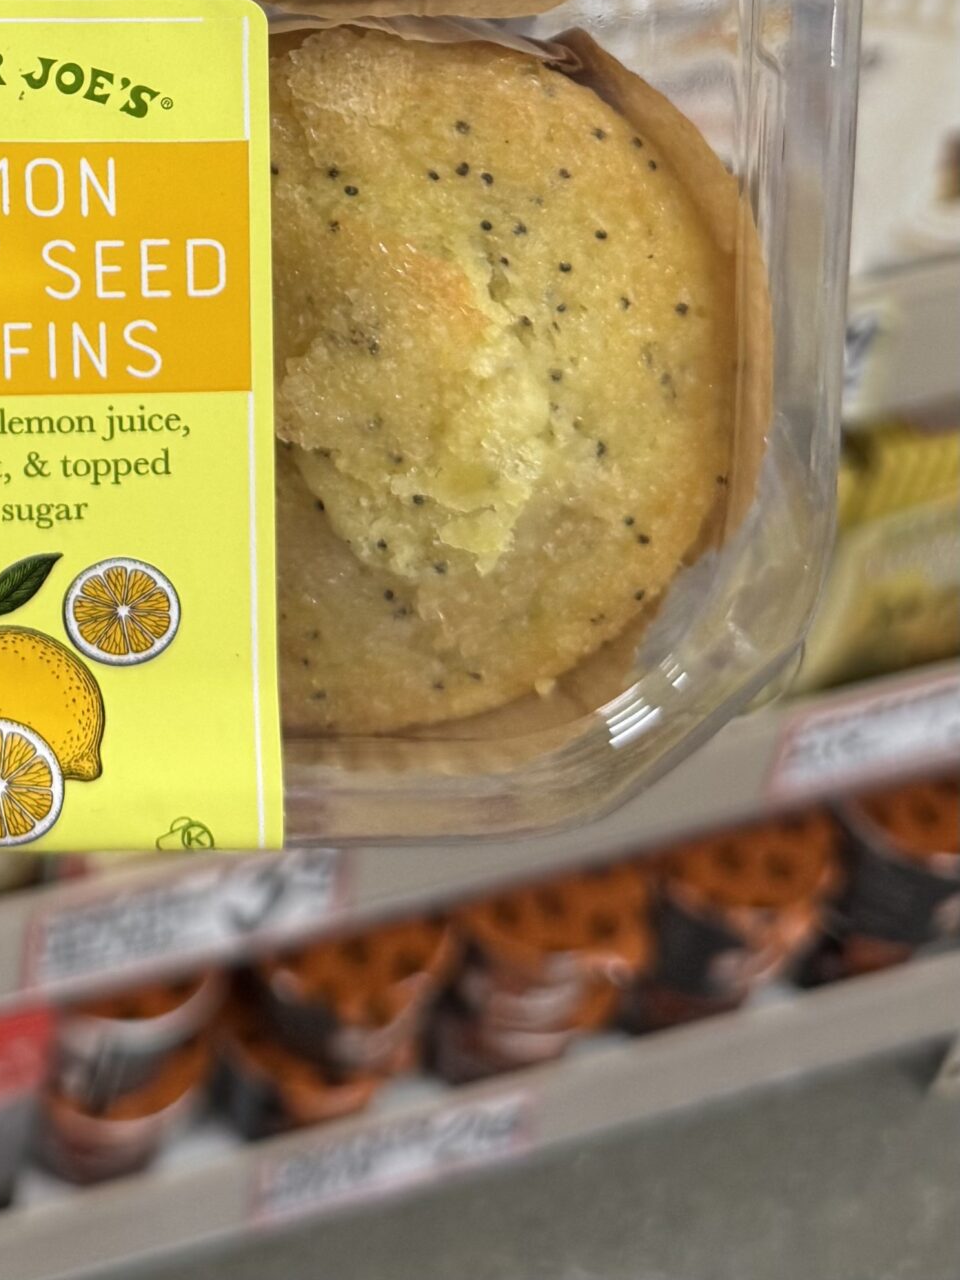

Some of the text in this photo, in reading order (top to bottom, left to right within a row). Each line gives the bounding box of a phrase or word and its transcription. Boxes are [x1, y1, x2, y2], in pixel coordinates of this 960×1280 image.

[41, 237, 228, 302] SEED
[101, 404, 192, 442] juice,
[22, 450, 52, 478] &
[60, 447, 172, 486] topped
[1, 499, 89, 530] sugar
